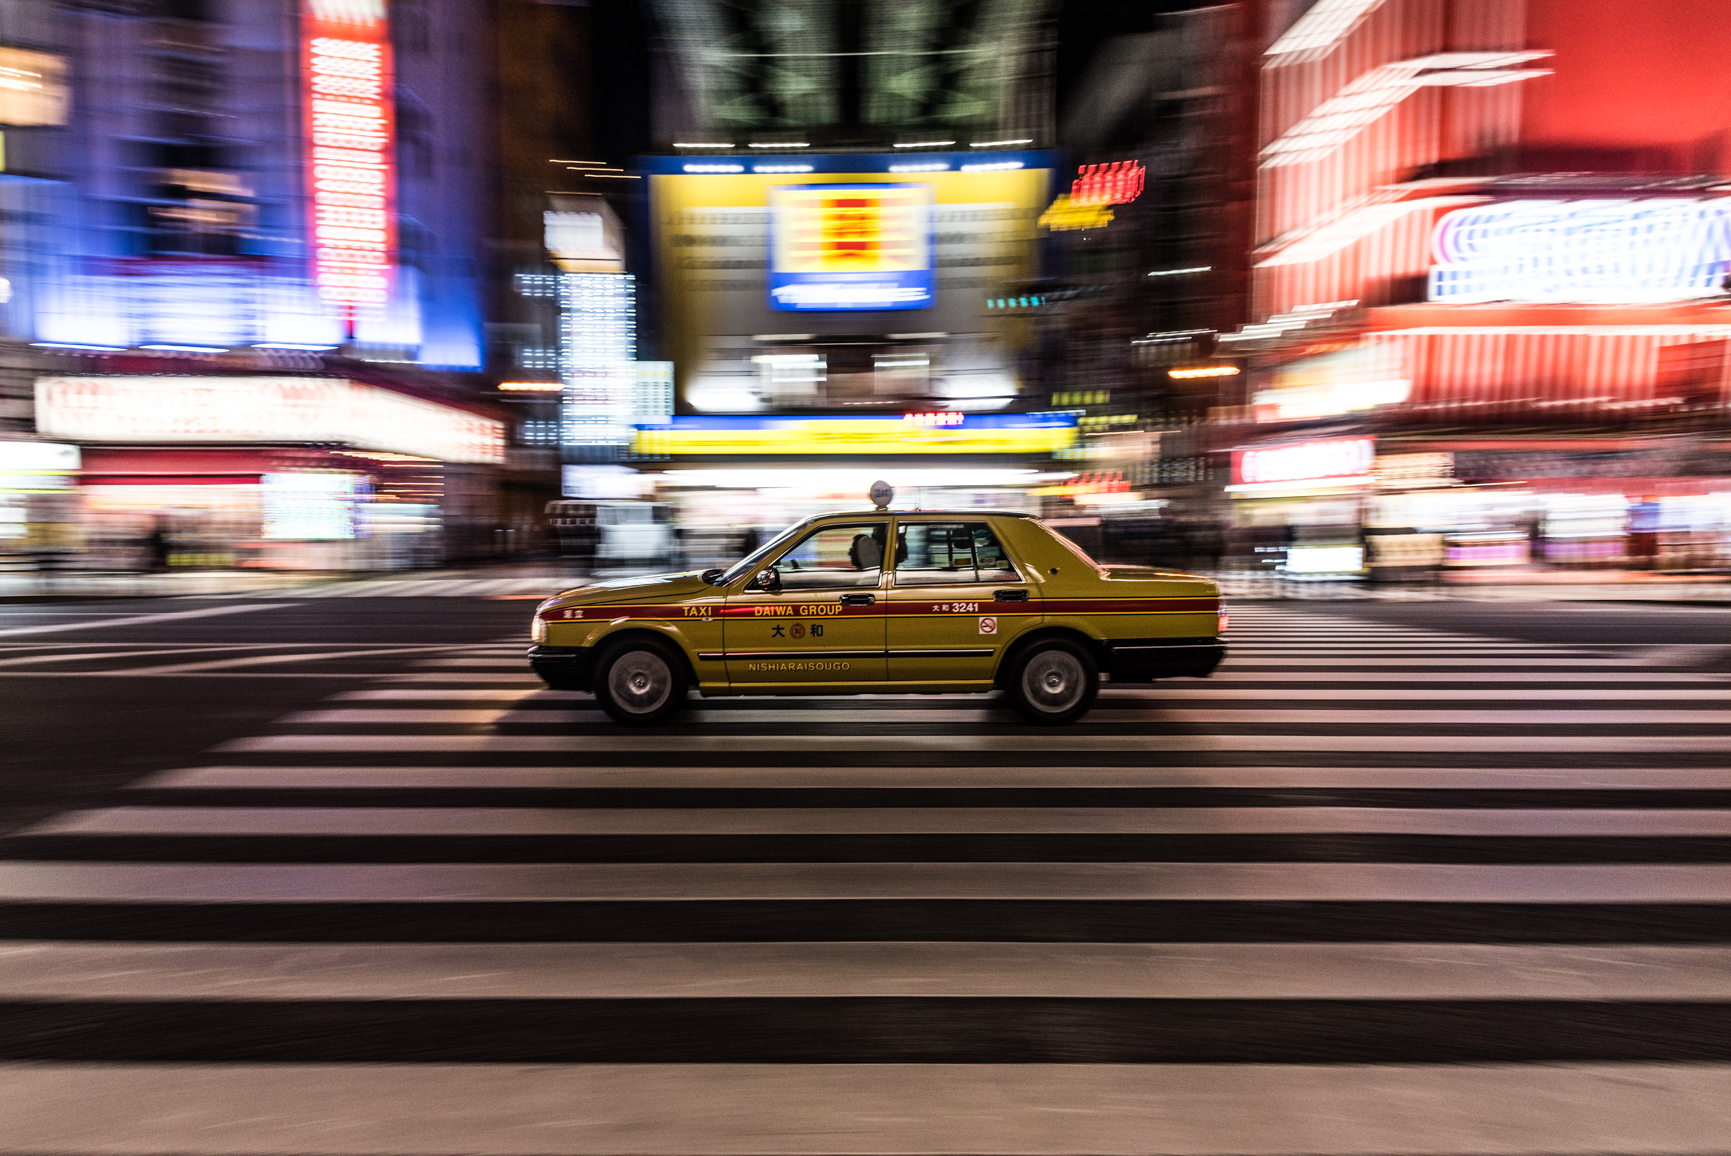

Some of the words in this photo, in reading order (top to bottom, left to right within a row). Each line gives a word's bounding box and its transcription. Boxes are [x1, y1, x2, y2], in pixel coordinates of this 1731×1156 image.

[682, 606, 712, 617] TAXI
[754, 605, 794, 616] DAIWA
[799, 604, 843, 615] GROUP
[952, 602, 979, 612] 3241
[771, 624, 785, 638] 大
[810, 623, 824, 638] 和
[748, 661, 851, 672] NISHIARAISOUGO
